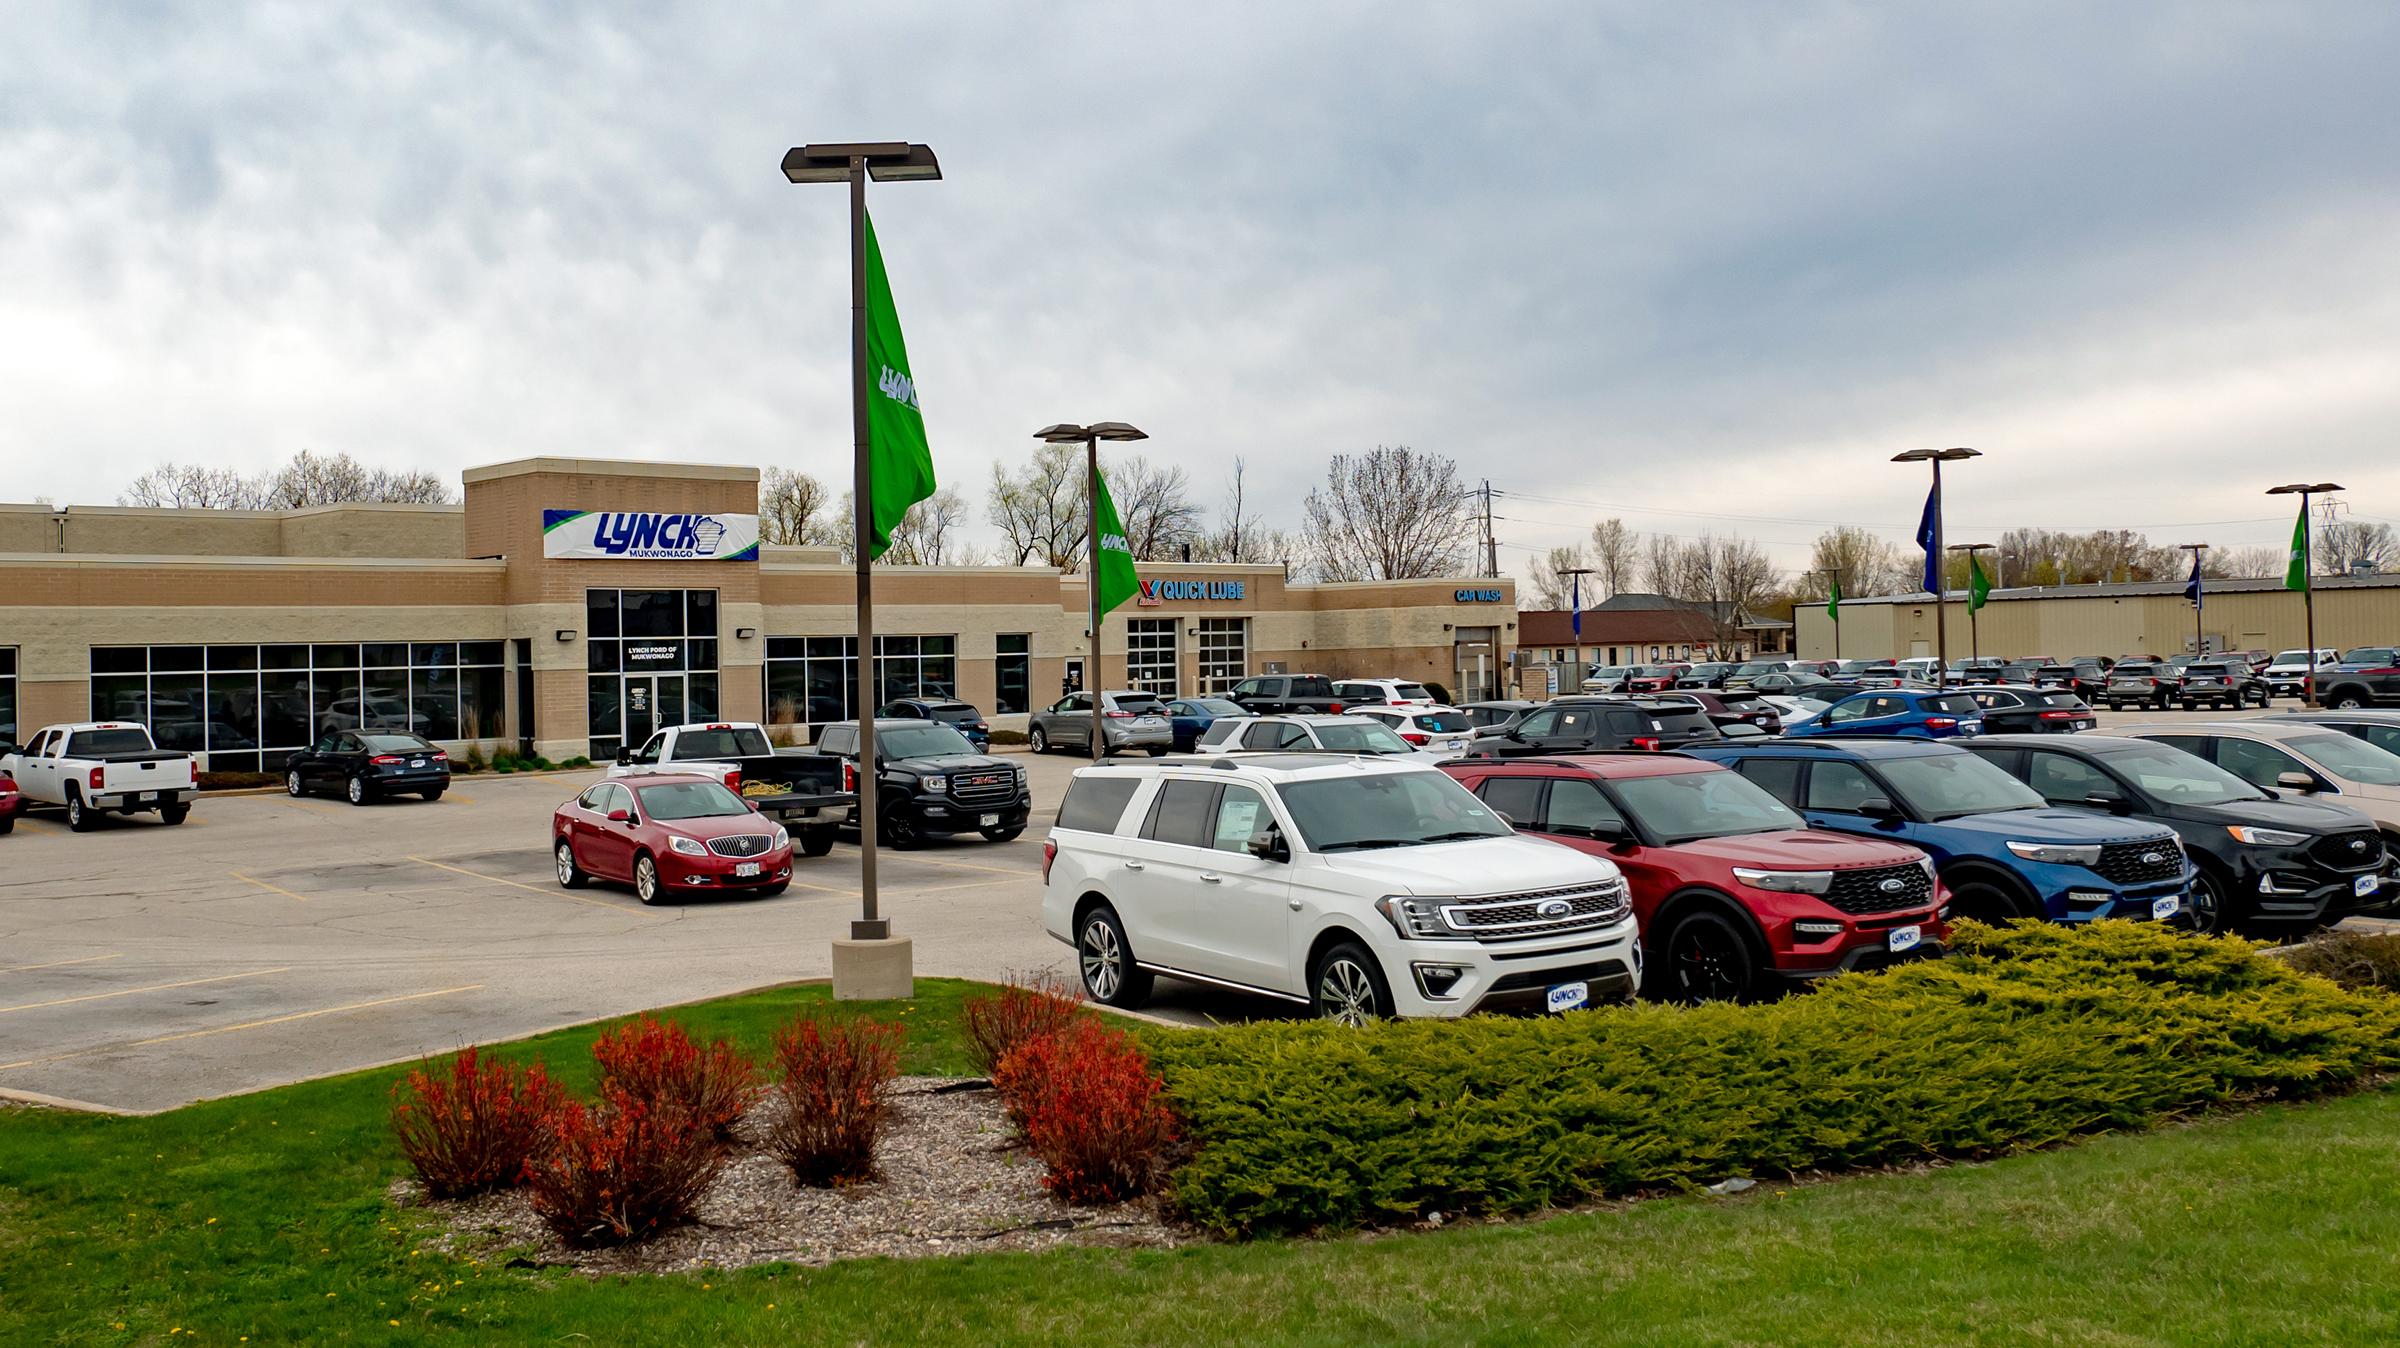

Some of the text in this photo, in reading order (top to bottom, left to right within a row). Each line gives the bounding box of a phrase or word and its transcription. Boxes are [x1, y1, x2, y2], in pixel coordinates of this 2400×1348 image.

[594, 513, 703, 554] LYNCH
[629, 550, 693, 558] MUKWONAGO
[1163, 580, 1246, 600] QUICK LUBE
[1456, 590, 1502, 602] CAR WASH
[972, 775, 998, 785] GMC
[1551, 989, 1577, 1004] LYNCH
